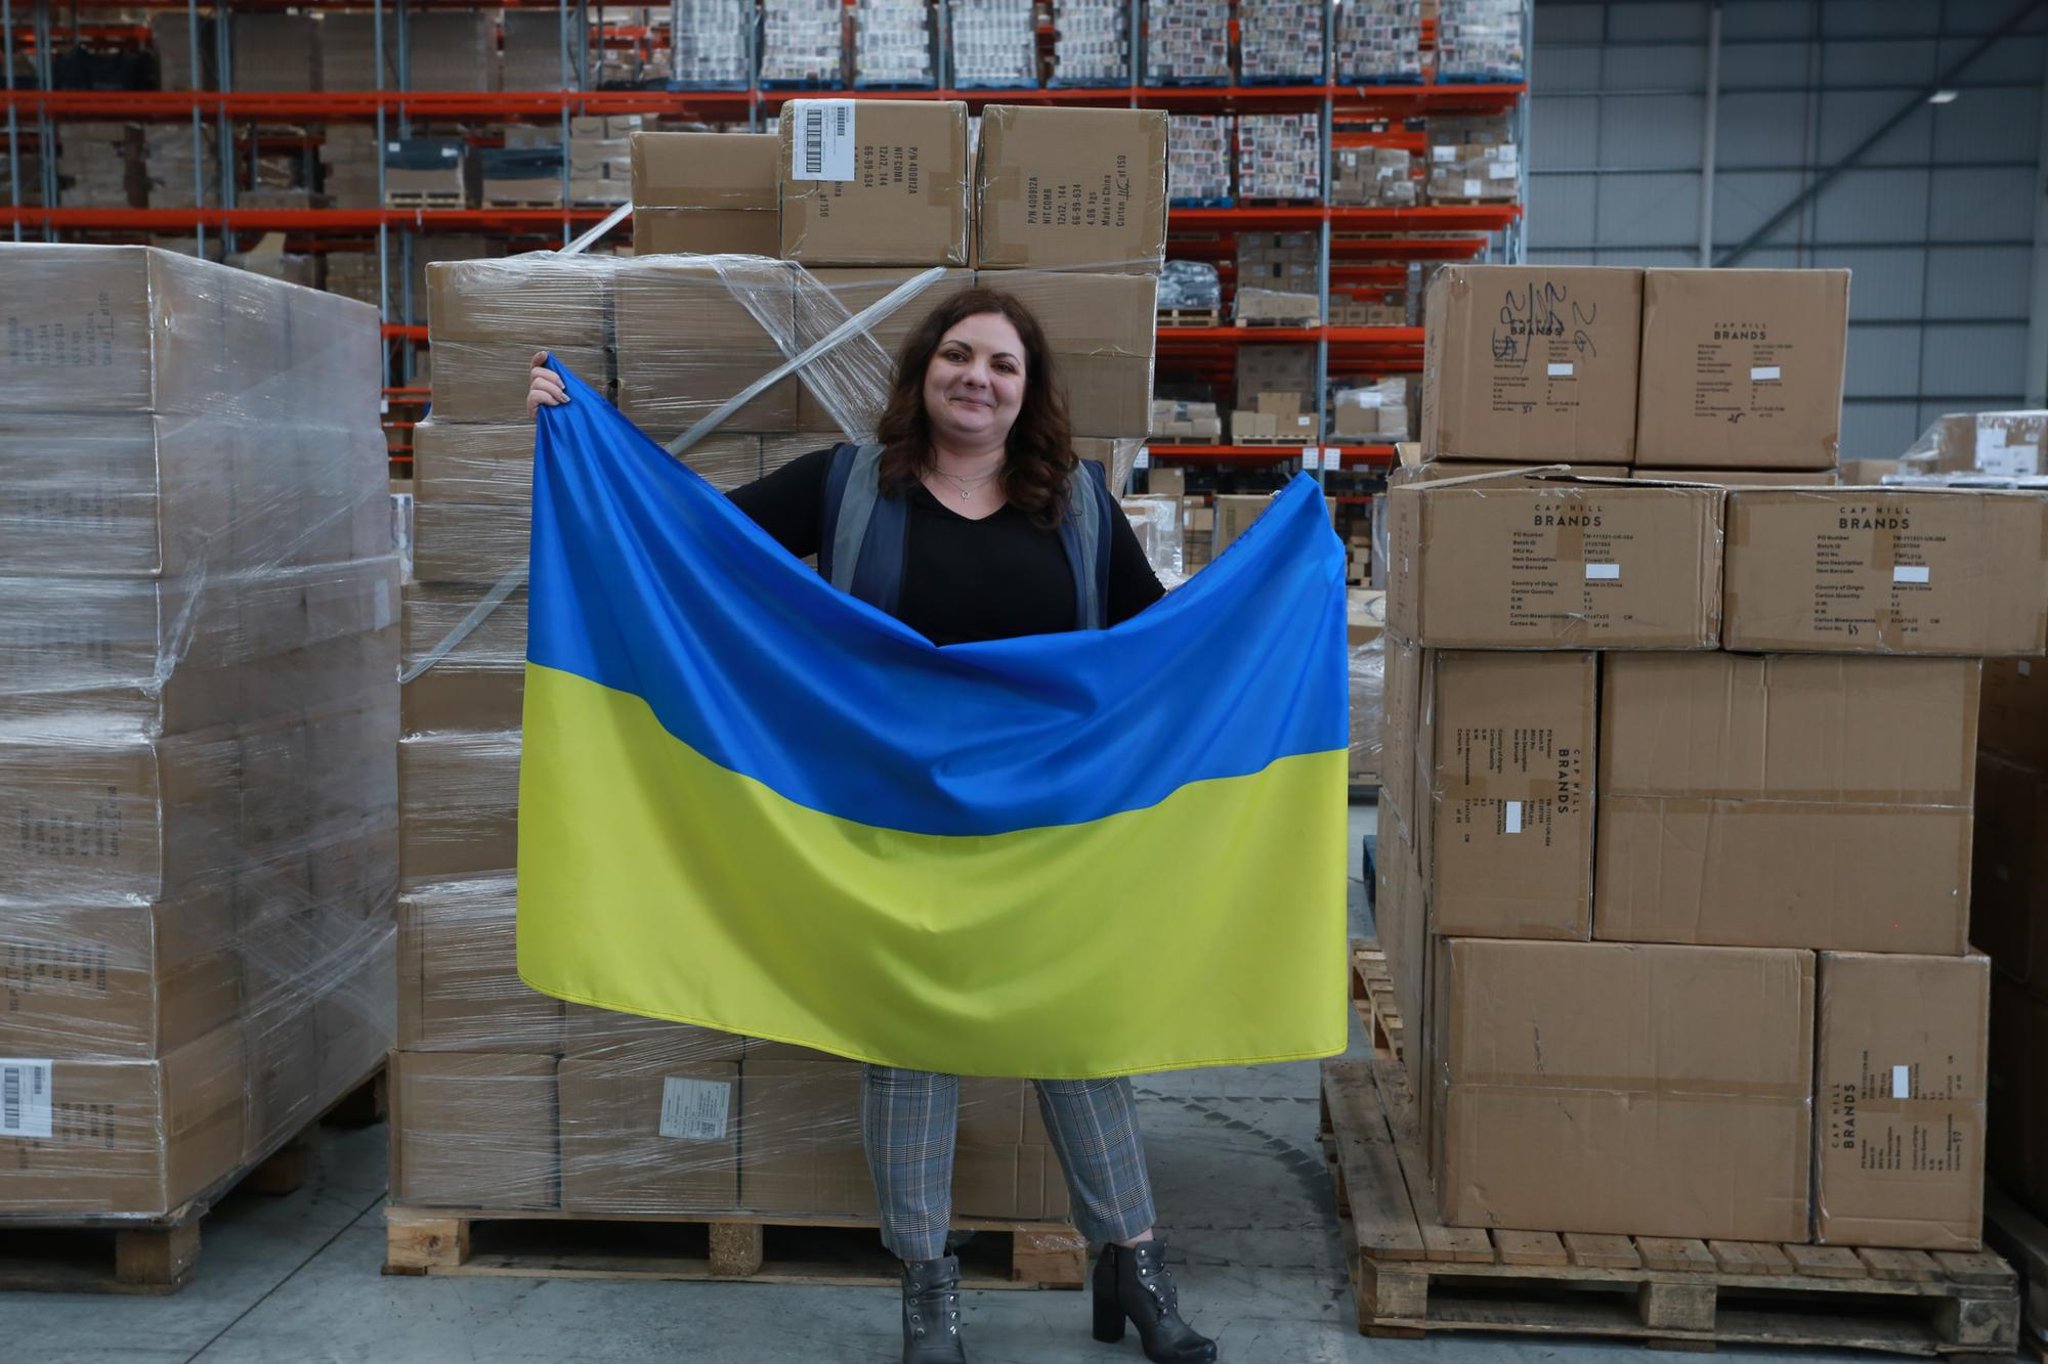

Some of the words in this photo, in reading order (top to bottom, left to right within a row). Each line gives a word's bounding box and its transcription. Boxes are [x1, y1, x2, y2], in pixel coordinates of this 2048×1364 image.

[894, 147, 903, 160] NIT
[908, 147, 918, 161] P/N
[1117, 155, 1126, 168] 150
[894, 161, 903, 183] COMB
[1102, 175, 1111, 196] China
[1043, 188, 1052, 210] COMB
[820, 204, 829, 217] 150
[1028, 211, 1037, 224] P/N
[1101, 207, 1110, 226] Made
[1116, 201, 1125, 227] Carton
[1042, 212, 1052, 224] NIT
[1714, 330, 1766, 340] BRANDS
[1534, 515, 1601, 526] BRANDS
[1839, 518, 1910, 529] BRANDS
[1557, 748, 1570, 814] BRANDS
[1843, 1083, 1855, 1149] BRANDS
[1832, 1123, 1840, 1148] CAP
